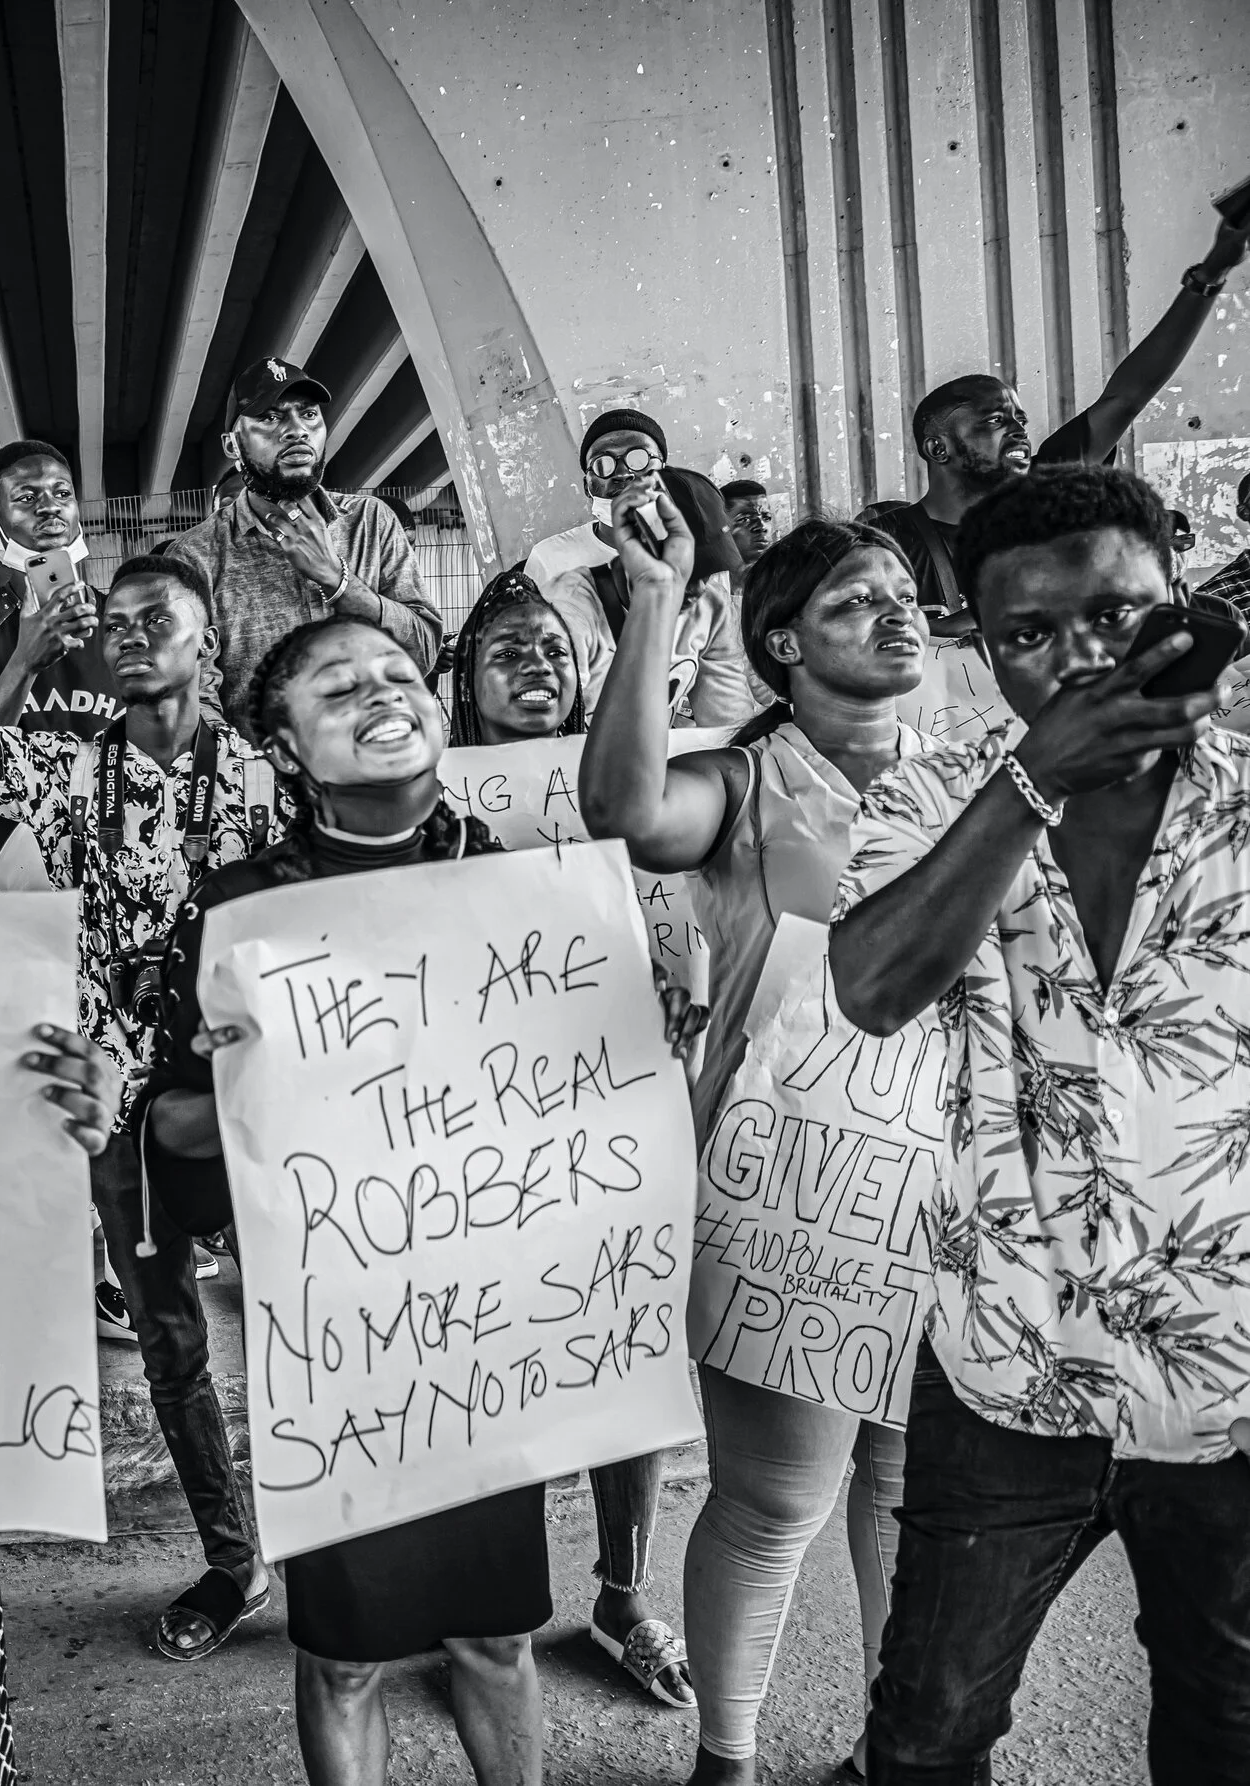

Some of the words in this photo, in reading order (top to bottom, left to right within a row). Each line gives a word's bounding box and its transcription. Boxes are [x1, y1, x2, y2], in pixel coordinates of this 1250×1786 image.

[105, 769, 116, 818] DIGITAL
[107, 744, 119, 767] EOS
[192, 775, 210, 822] Canon
[478, 929, 608, 1023] ARE
[351, 1064, 477, 1150] THE
[480, 1036, 656, 1127] REAL
[283, 1128, 642, 1269] ROBBERS
[259, 1275, 343, 1409] NO
[361, 1279, 511, 1374] MORE
[528, 1222, 676, 1323] SARS
[782, 1273, 899, 1315] BRUTALITY
[258, 1380, 416, 1491] SAY
[428, 1360, 504, 1448] NO
[509, 1347, 548, 1413] TO
[556, 1301, 672, 1389] SARS
